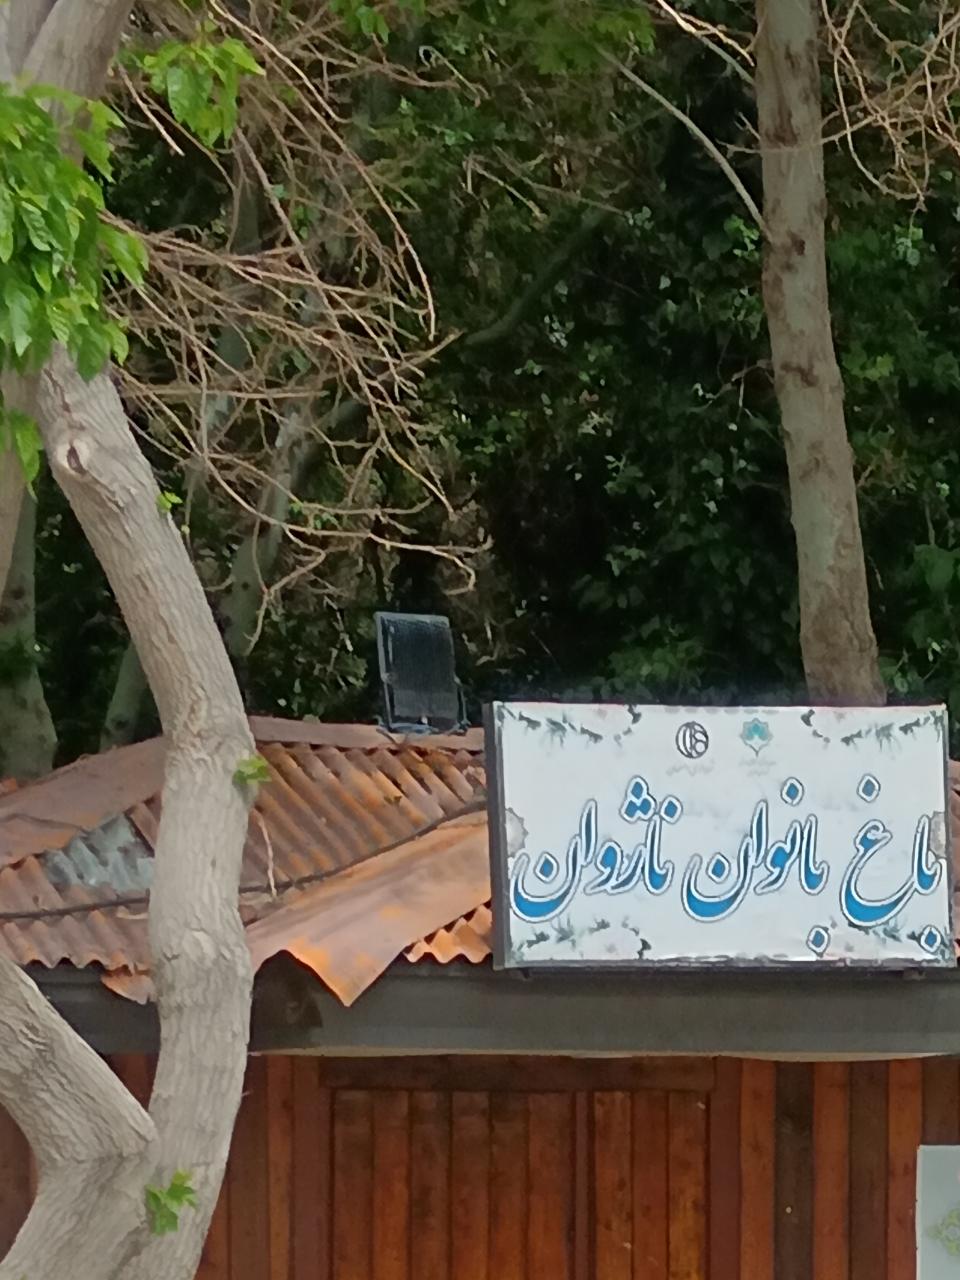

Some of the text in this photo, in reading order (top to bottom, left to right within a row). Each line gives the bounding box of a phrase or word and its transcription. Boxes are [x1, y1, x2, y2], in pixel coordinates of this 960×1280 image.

[509, 774, 950, 953] باغ بانوان ناژوان
